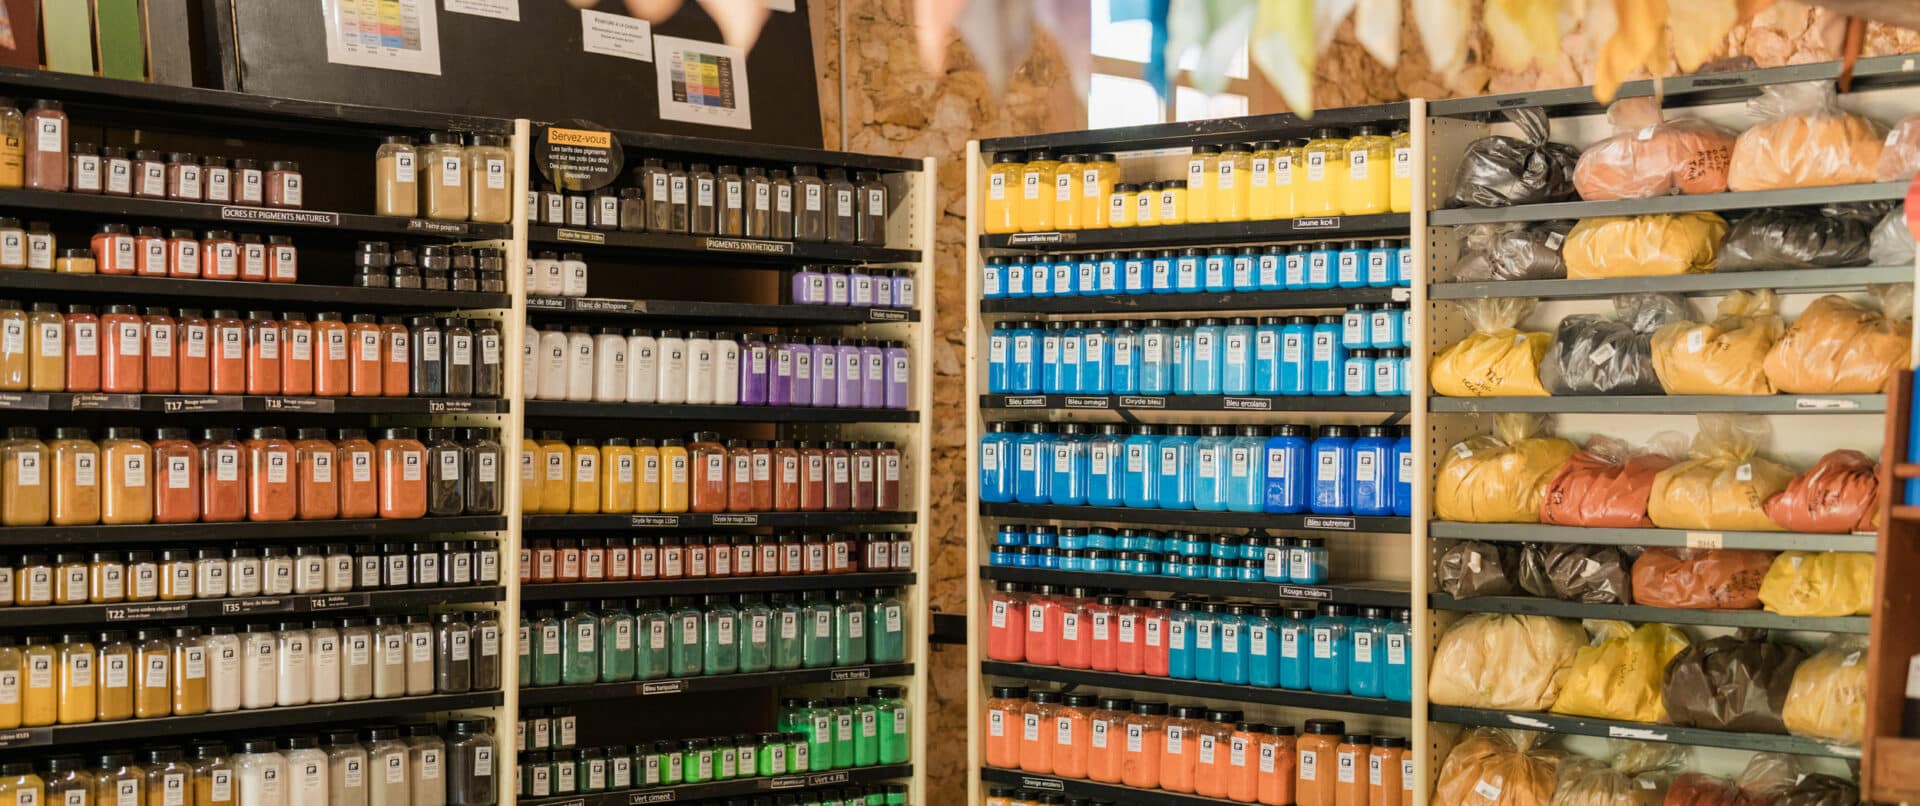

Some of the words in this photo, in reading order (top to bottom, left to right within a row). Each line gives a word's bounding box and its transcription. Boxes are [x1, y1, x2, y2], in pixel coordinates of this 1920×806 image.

[551, 130, 608, 145] Servez-vous
[223, 208, 248, 218] OCRES
[249, 210, 258, 219] ET
[258, 210, 295, 222] PIGMENTS
[296, 213, 331, 224] NATURELS
[1297, 218, 1319, 227] Jaune
[708, 240, 740, 250] PIGMENTS
[740, 241, 784, 253] SYNTHETIQUES
[166, 400, 182, 410] T17
[267, 399, 282, 409] T18
[1067, 398, 1082, 406] Bleu
[1125, 397, 1145, 406] Oxyde
[1147, 398, 1162, 406] bleu
[1226, 399, 1240, 407] Bleu
[1240, 400, 1267, 408] ercolano
[431, 402, 445, 411] T20
[1307, 518, 1321, 527] Bleu
[1283, 586, 1303, 597] Rouge
[224, 603, 240, 613] T35
[311, 599, 327, 608] T41
[108, 609, 125, 619] T22
[835, 671, 848, 680] Vert
[633, 795, 648, 803] Vert
